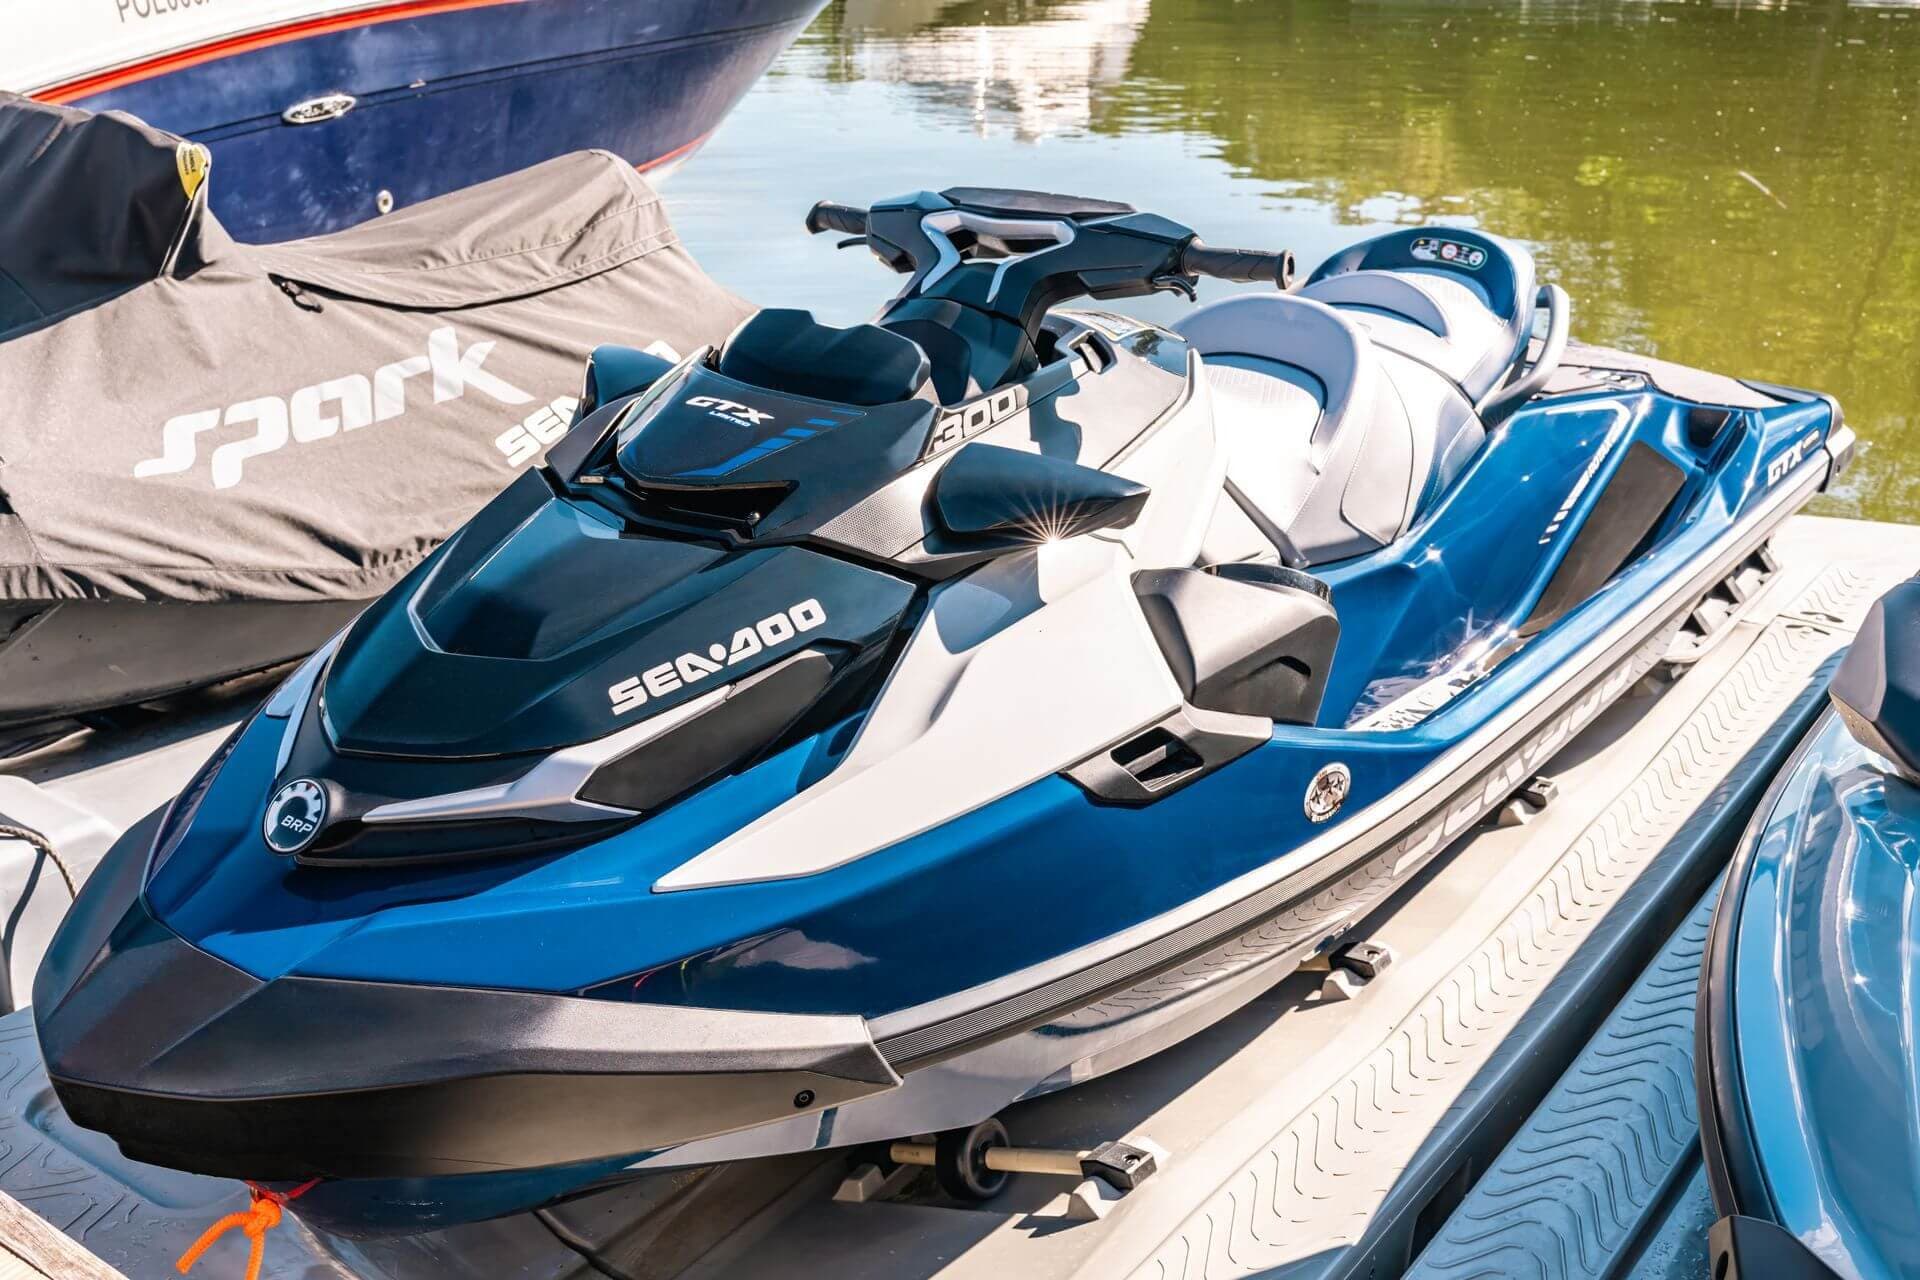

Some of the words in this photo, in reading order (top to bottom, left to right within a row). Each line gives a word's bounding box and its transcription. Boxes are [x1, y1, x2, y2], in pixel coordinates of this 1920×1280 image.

[134, 326, 536, 490] spark
[685, 396, 775, 424] GTX
[933, 388, 1018, 454] 300
[1767, 440, 1803, 487] GTX
[281, 814, 313, 833] BRP
